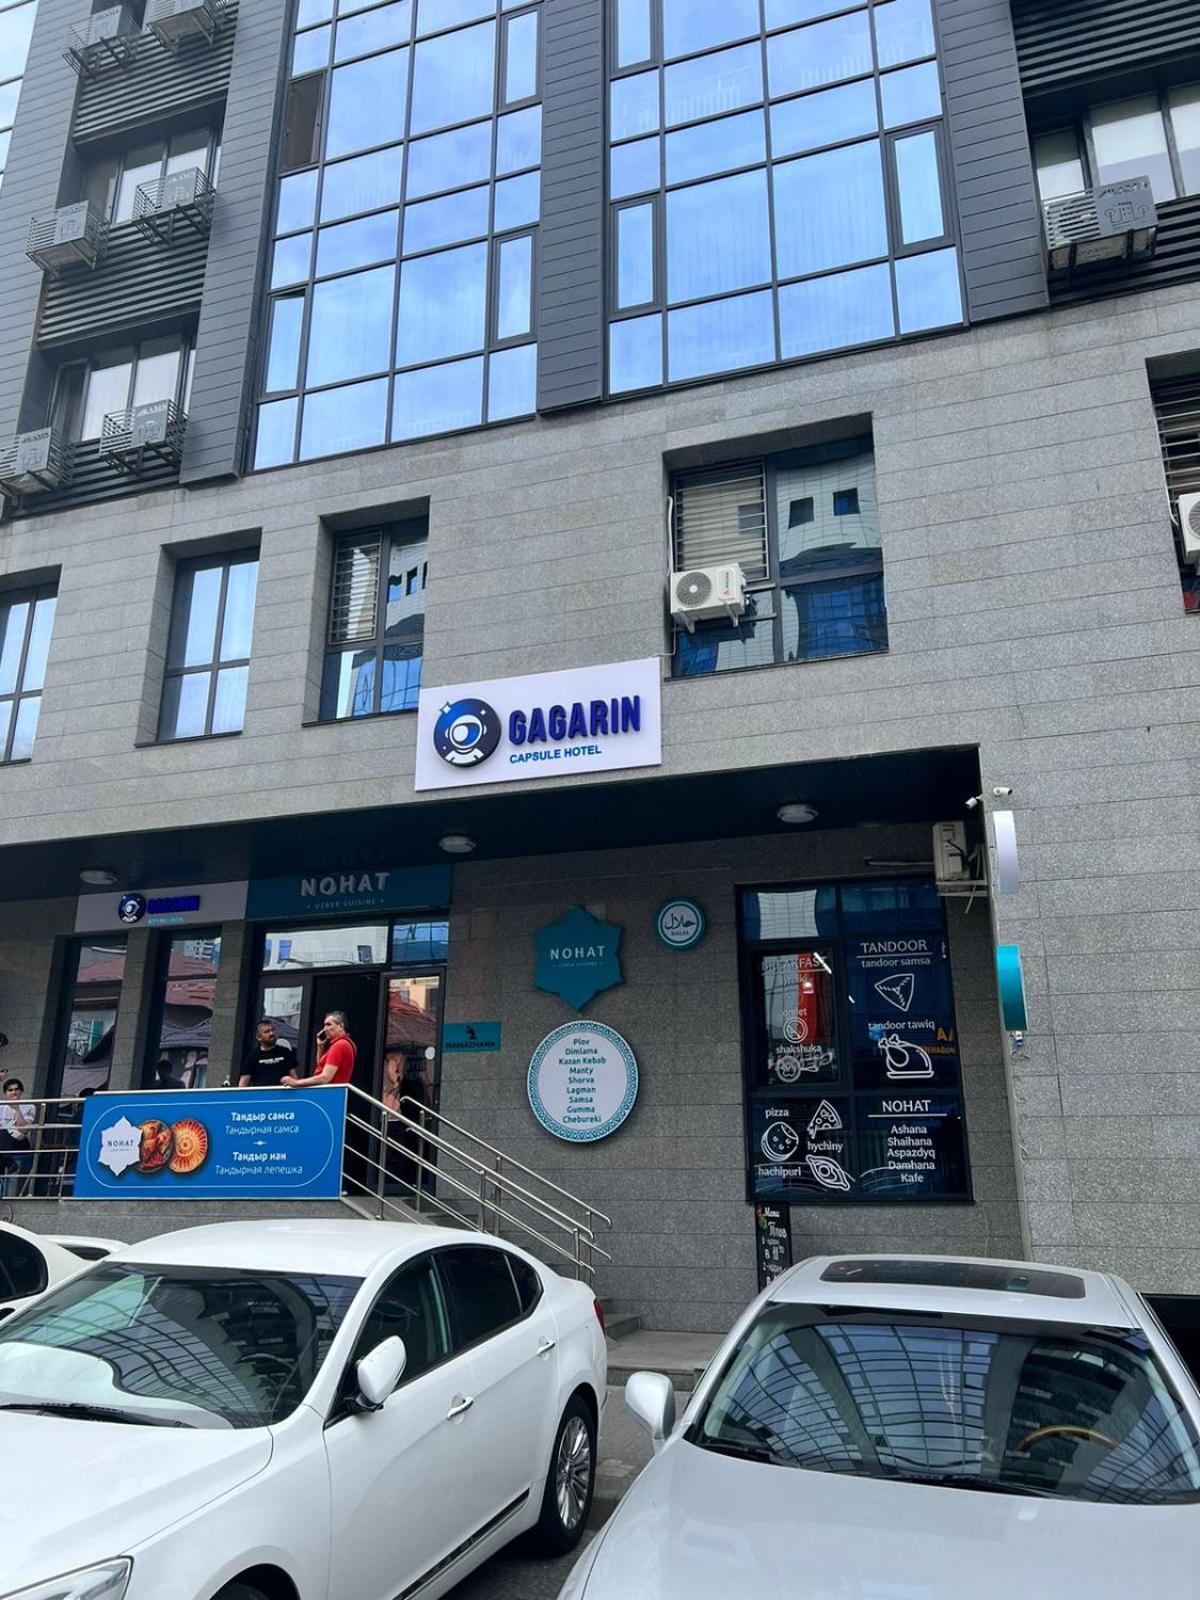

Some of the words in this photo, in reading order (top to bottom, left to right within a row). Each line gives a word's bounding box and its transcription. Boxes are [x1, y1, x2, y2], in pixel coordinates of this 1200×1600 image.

[508, 695, 641, 746] GAGARIN
[509, 749, 562, 764] CAPSULE
[564, 745, 602, 757] HOTEL
[301, 871, 391, 897] NOHAT
[664, 913, 696, 930] حلال
[860, 939, 928, 954] TANDOOR
[550, 945, 606, 960] NOHAT
[861, 957, 898, 968] tandoor
[900, 957, 931, 967] samsa
[867, 1019, 904, 1031] tandoor
[907, 1019, 935, 1031] tawiq
[573, 1038, 590, 1046] Plov
[565, 1047, 598, 1055] Dimlama
[775, 1043, 822, 1054] shakshuka
[559, 1057, 581, 1065] Kazan
[582, 1056, 606, 1064] Kebab
[569, 1067, 594, 1075] Manty
[568, 1076, 595, 1084] Shorva
[566, 1086, 596, 1095] Lagman
[568, 1096, 594, 1104] Samsa
[882, 1099, 931, 1113] NOHAT
[231, 1111, 266, 1122] Тандыр
[267, 1111, 295, 1120] самса
[765, 1108, 790, 1118] pizza
[563, 1115, 602, 1123] Chebureki
[225, 1125, 272, 1135] Тандырная
[273, 1125, 299, 1134] самса
[890, 1124, 928, 1134] Ashana
[807, 1140, 843, 1152] hychiny
[232, 1151, 268, 1162] Тандыр
[269, 1152, 287, 1160] нан
[887, 1147, 936, 1159] Aspazdyq
[888, 1159, 936, 1170] Damhana
[215, 1165, 262, 1176] Тандырная
[263, 1166, 303, 1175] лепешка
[758, 1165, 801, 1177] hachipuri
[901, 1172, 924, 1182] Kafe
